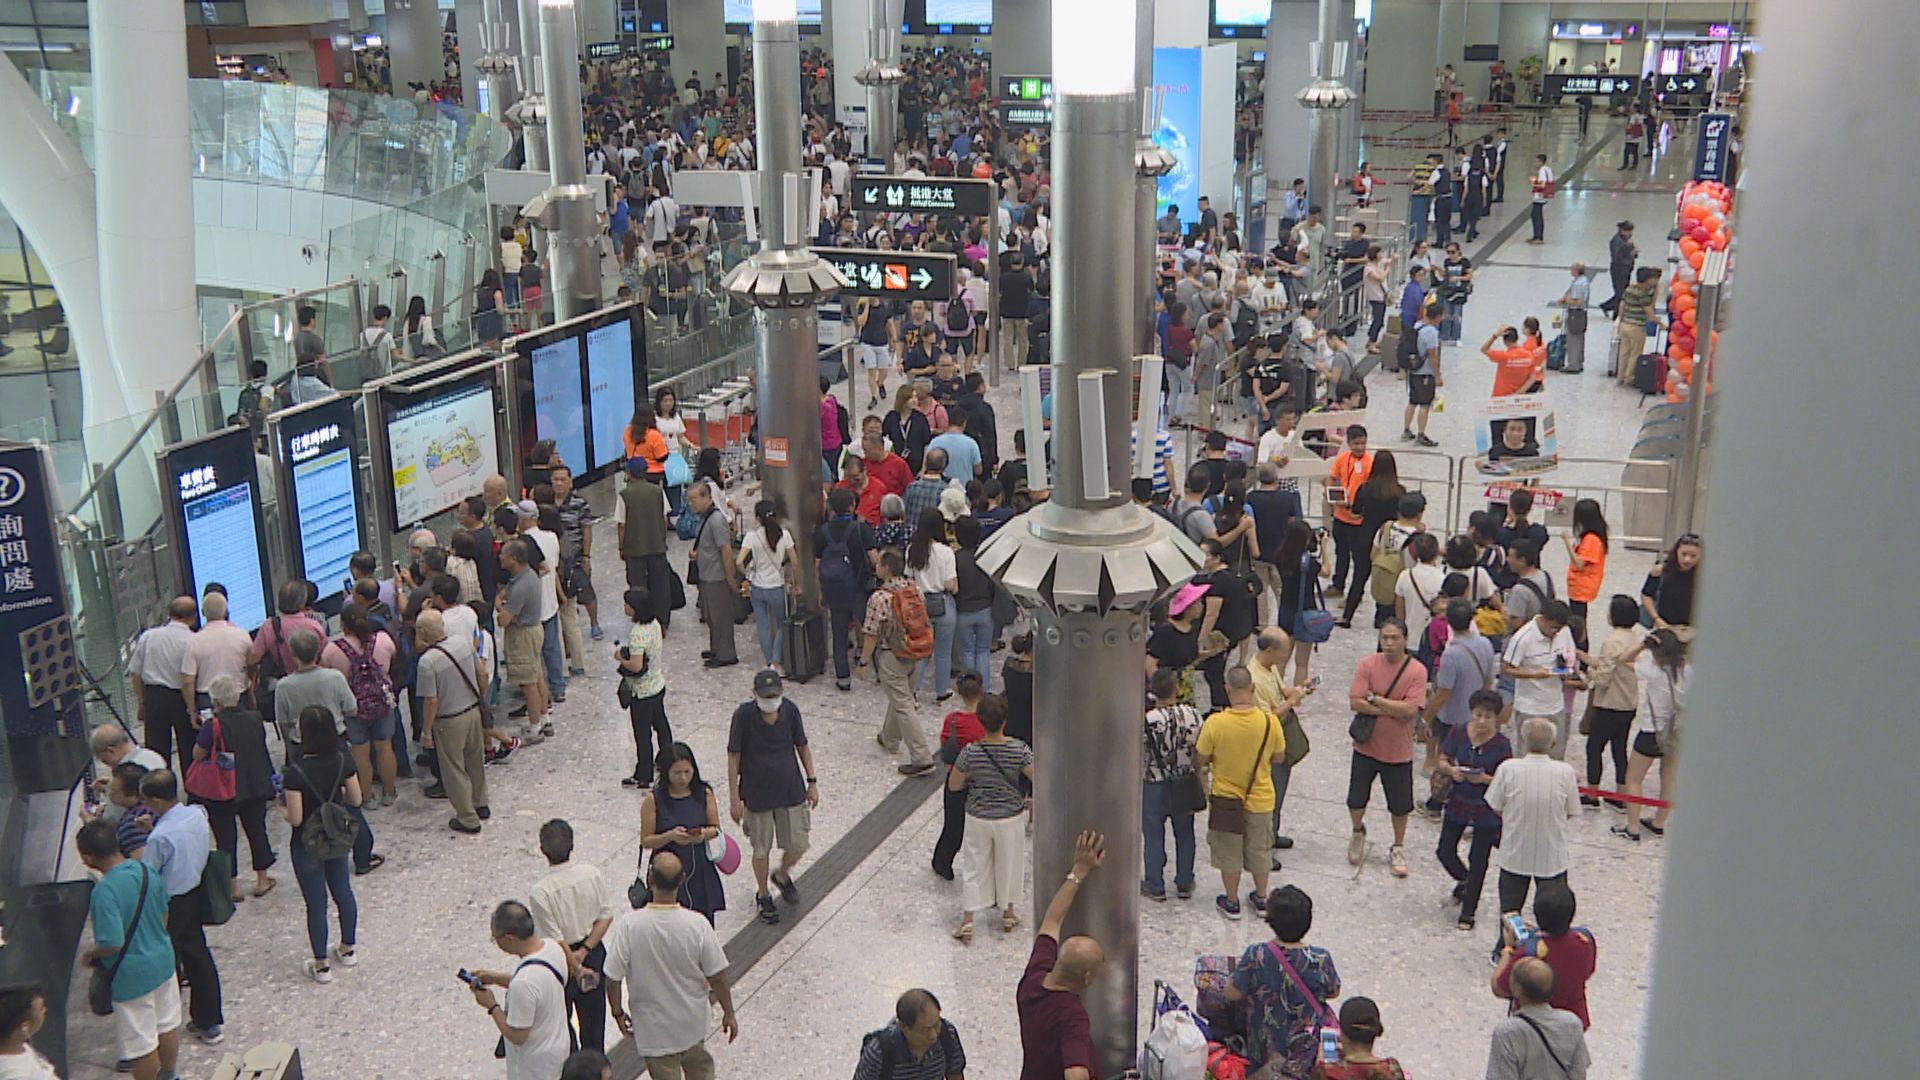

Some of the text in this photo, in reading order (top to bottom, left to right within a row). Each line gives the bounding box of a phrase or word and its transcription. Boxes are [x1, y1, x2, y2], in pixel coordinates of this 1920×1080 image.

[910, 185, 953, 201] 抵港大堂
[910, 200, 927, 208] Arrival
[0, 514, 34, 593] 詢問處
